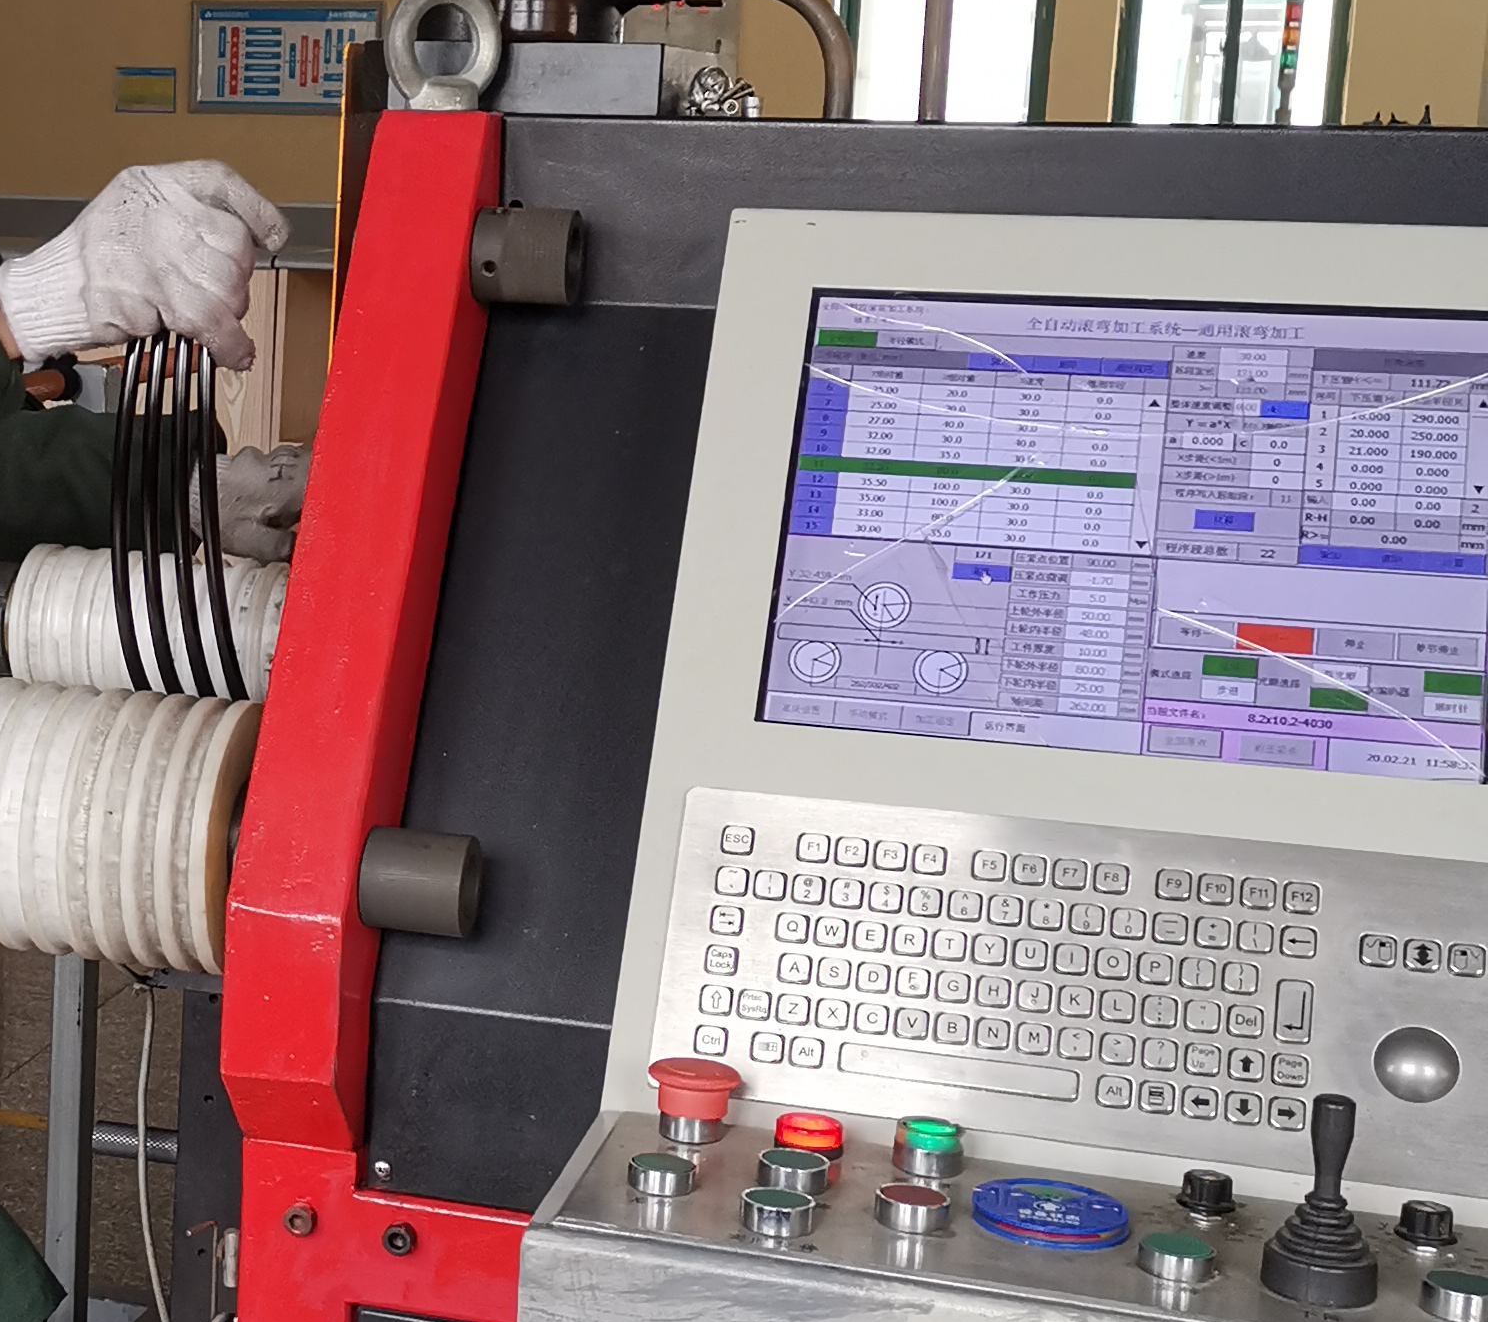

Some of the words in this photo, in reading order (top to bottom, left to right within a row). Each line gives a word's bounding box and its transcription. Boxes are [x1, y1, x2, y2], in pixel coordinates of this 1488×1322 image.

[868, 417, 895, 425] 27.00
[1095, 412, 1112, 420] 0.0
[1321, 410, 1326, 419] 1
[1412, 414, 1460, 424] 290.000
[820, 429, 828, 437] 9
[867, 431, 893, 440] 32.00
[941, 435, 962, 444] 30.0
[1091, 443, 1109, 451] 0.0
[1319, 427, 1327, 436] 2
[1350, 429, 1390, 439] 20.000
[1411, 432, 1458, 442] 250.000
[1192, 436, 1224, 446] 0.000
[1270, 439, 1288, 449] 0.0
[864, 447, 891, 455] 32.00
[939, 451, 960, 459] 35.0
[1090, 459, 1107, 467] 0.0
[1318, 445, 1326, 453] 3
[1349, 446, 1388, 456] 21.000
[1411, 449, 1458, 459] 190.000
[1273, 458, 1281, 467] 0
[1316, 463, 1323, 471] 4
[1351, 464, 1384, 474] 0.000
[1416, 467, 1449, 477] 0.000
[1272, 476, 1279, 485] 0
[1316, 479, 1323, 488] 5
[1349, 482, 1382, 492] 0.000
[1415, 485, 1448, 495] 0.000
[861, 478, 887, 487] 35.50
[933, 482, 960, 491] 100.0
[1087, 491, 1104, 500] 0.0
[859, 494, 886, 502] 35.00
[931, 498, 958, 507] 100.0
[1007, 503, 1030, 511] 30.0
[1085, 507, 1102, 516] 0.0
[1351, 498, 1376, 507] 0.00
[1415, 501, 1441, 511] 0.00
[1471, 504, 1479, 513] 2
[857, 508, 884, 517] 33.00
[1006, 518, 1027, 527] 30.0
[1084, 523, 1101, 531] 0.0
[1349, 515, 1375, 525] 0.00
[1414, 519, 1441, 528] 0.00
[855, 524, 882, 533] 30.00
[1004, 534, 1026, 543] 30.0
[1082, 539, 1099, 548] 0.0
[1381, 535, 1407, 545] 0.00
[1260, 549, 1276, 559] 22
[1087, 559, 1117, 568] 90.00
[1089, 595, 1106, 603] 5.0
[1081, 612, 1111, 621] 50.00
[1079, 649, 1107, 658] 10.00
[1075, 666, 1105, 676] 80.00
[1074, 684, 1104, 694] 75.00
[1069, 701, 1105, 712] 262.00
[1247, 713, 1333, 730] 8.2x10.2-4030
[1367, 754, 1416, 765] 20.02.21
[725, 834, 750, 844] ESC
[807, 841, 821, 852] F1
[844, 846, 860, 856] F2
[883, 850, 899, 860] F3
[922, 853, 937, 864] F4
[982, 860, 998, 870] F5
[1022, 864, 1037, 873] F6
[1062, 868, 1078, 878] F7
[1104, 872, 1120, 882] F8
[1166, 878, 1182, 889] F9
[1205, 883, 1227, 895] F10
[1249, 888, 1269, 899] F11
[1291, 892, 1314, 903] F12
[803, 889, 811, 900] 2
[841, 892, 850, 903] 3
[881, 899, 889, 909] 4
[921, 902, 929, 912] 5
[960, 907, 968, 916] 6
[1001, 910, 1008, 920] 7
[1042, 916, 1050, 925] 8
[1083, 920, 1091, 930] 9
[1125, 925, 1132, 934] 0
[786, 920, 799, 933] Q
[824, 925, 840, 937] W
[865, 929, 876, 941] E
[904, 933, 915, 946] R
[944, 938, 955, 950] T
[984, 943, 996, 954] Y
[1025, 947, 1036, 959] U
[1070, 952, 1074, 964] I
[1107, 955, 1120, 969] O
[1149, 961, 1161, 973] P
[710, 949, 733, 960] Caps
[709, 959, 731, 969] Lock
[788, 961, 800, 974] A
[828, 966, 840, 978] S
[868, 970, 879, 983] D
[908, 972, 918, 983] F
[947, 980, 960, 992] G
[988, 986, 999, 997] H
[1031, 987, 1039, 999] J
[1069, 994, 1081, 1006] K
[1113, 1000, 1123, 1012] L
[1235, 1014, 1257, 1027] Del
[788, 1003, 799, 1014] Z
[827, 1007, 839, 1019] X
[866, 1012, 878, 1024] C
[906, 1017, 918, 1028] V
[947, 1022, 958, 1034] B
[987, 1027, 999, 1039] N
[1028, 1032, 1040, 1044] M
[1191, 1046, 1216, 1057] Page
[702, 1034, 721, 1046] Ctrl
[798, 1047, 814, 1058] Alt
[1106, 1086, 1123, 1097] Alt
[1278, 1057, 1303, 1069] Page
[1277, 1071, 1304, 1081] Down
